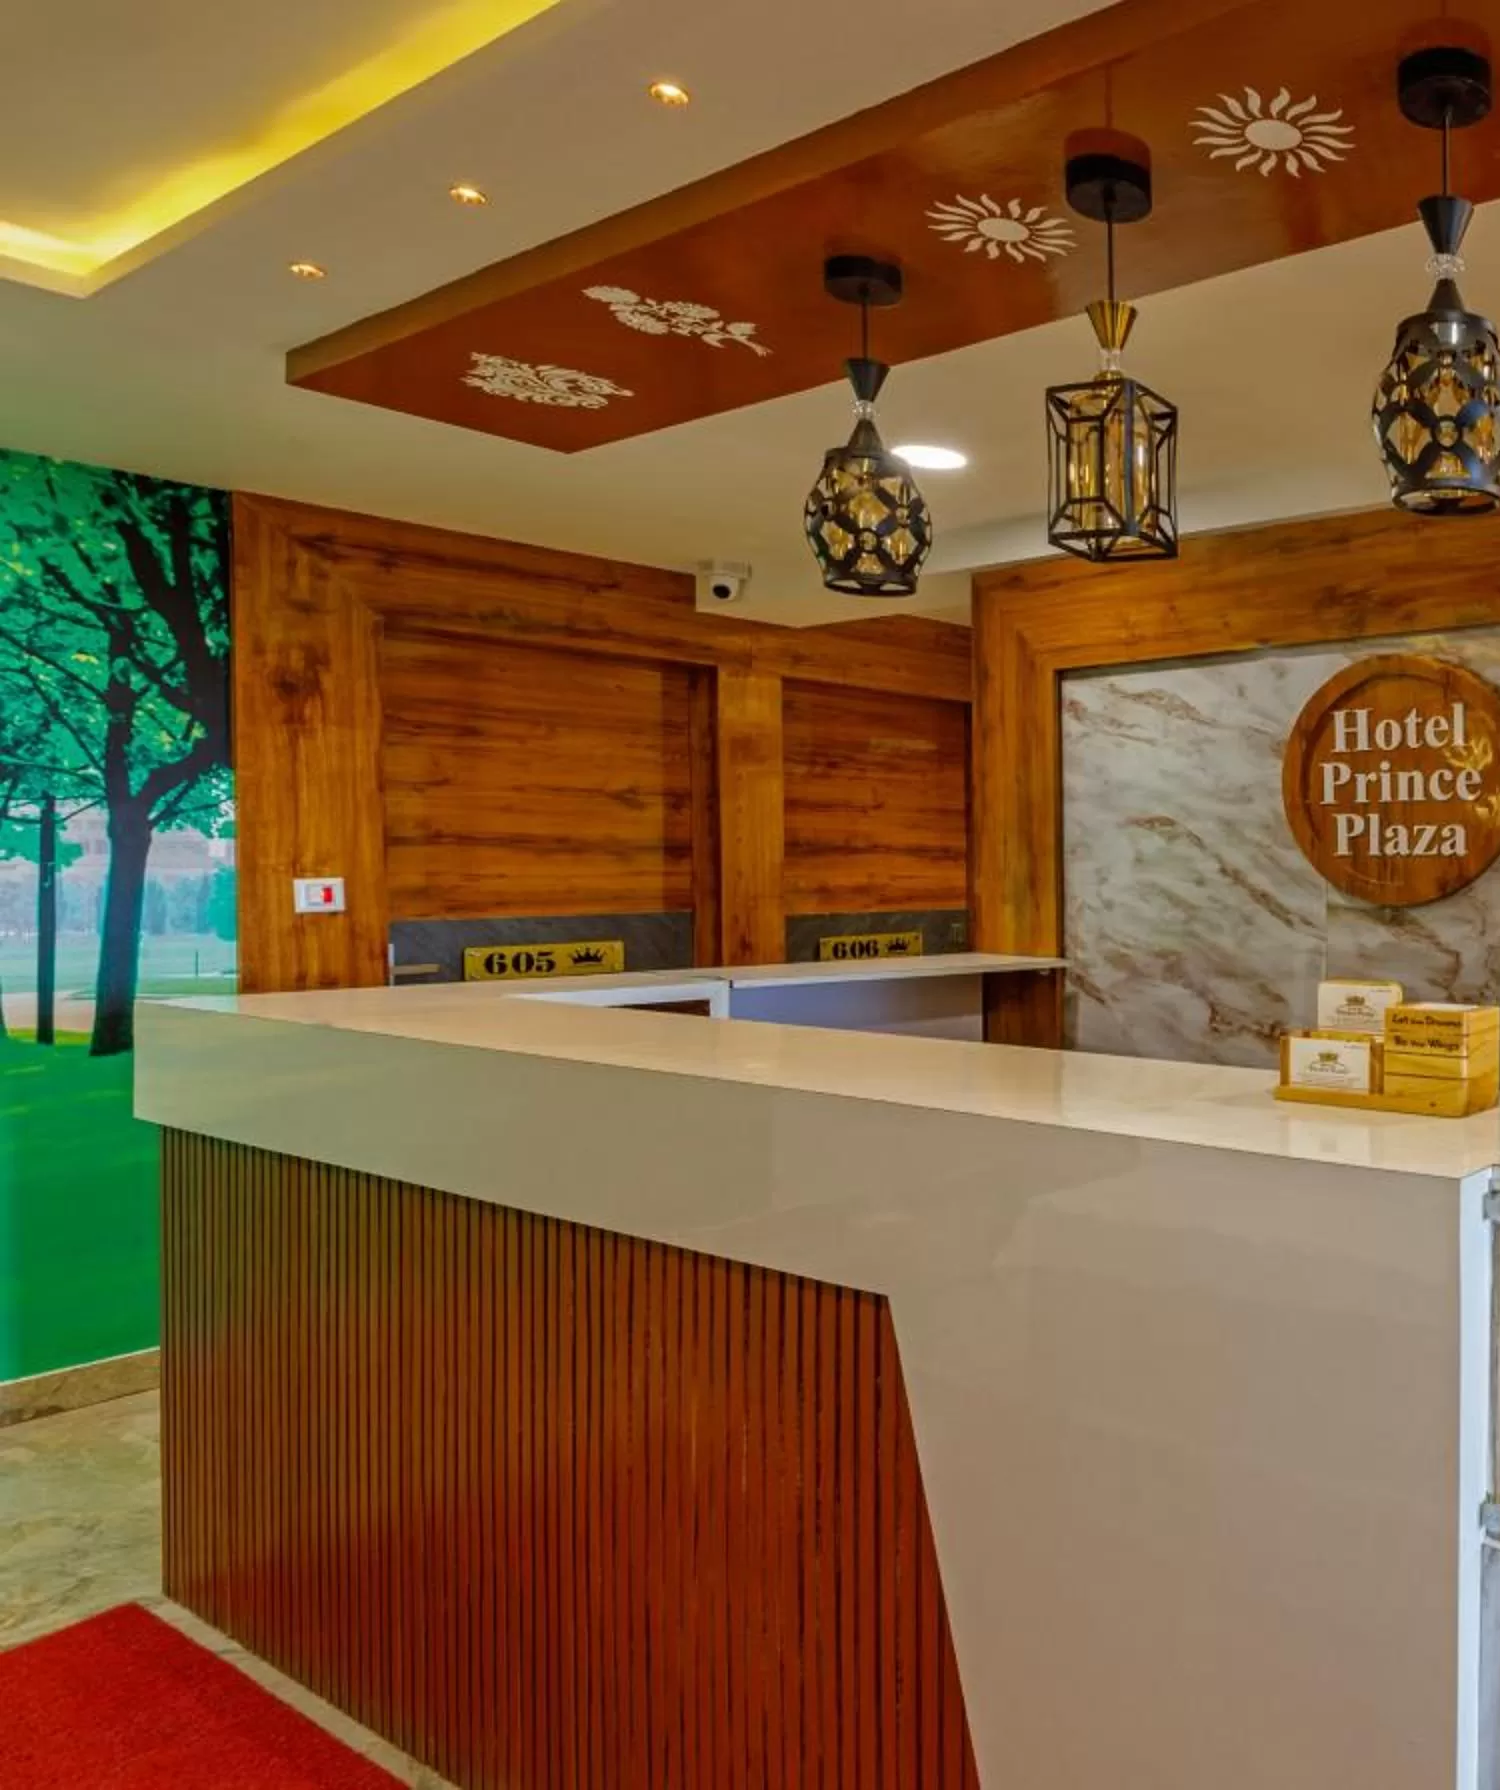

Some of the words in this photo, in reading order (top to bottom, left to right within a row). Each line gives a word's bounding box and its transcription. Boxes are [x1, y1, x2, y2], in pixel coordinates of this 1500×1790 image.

[1331, 702, 1469, 753] Hotel
[1319, 760, 1483, 805] Prince
[1333, 813, 1469, 857] Plaza
[484, 951, 556, 974] 605
[832, 940, 878, 959] 606
